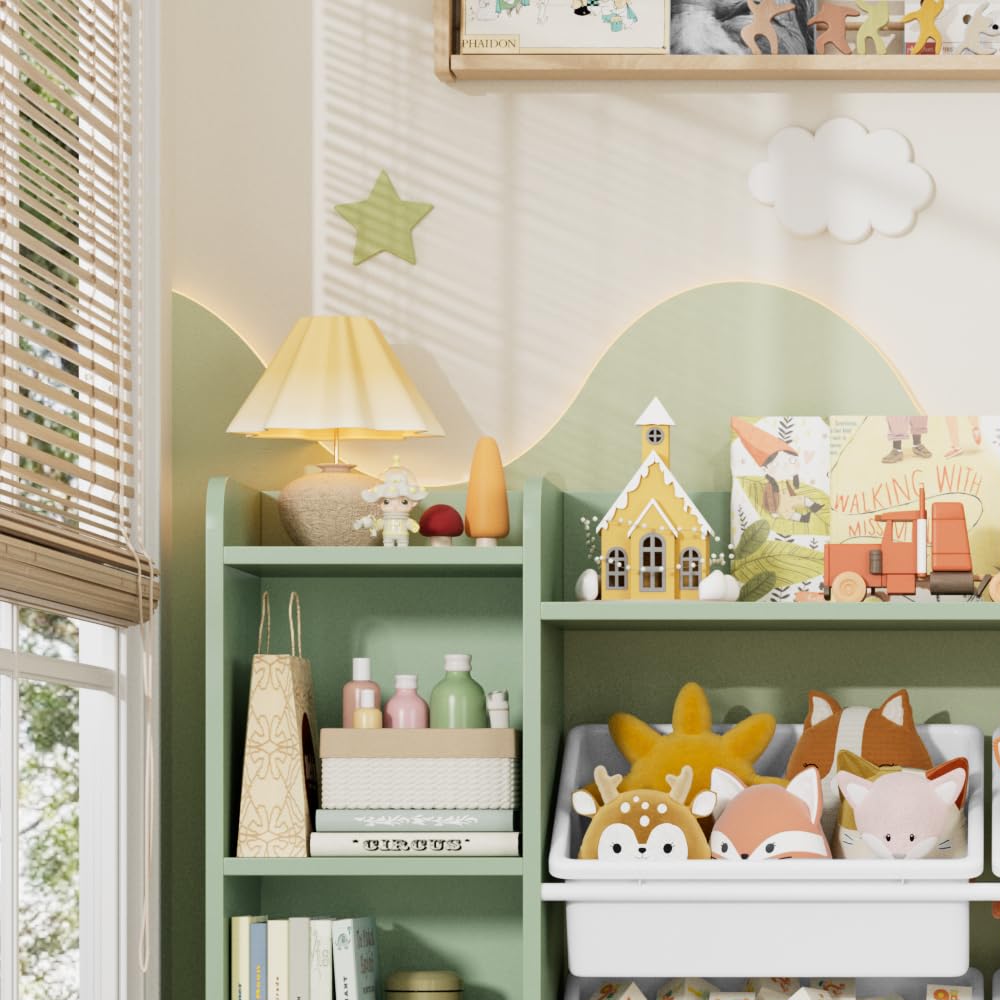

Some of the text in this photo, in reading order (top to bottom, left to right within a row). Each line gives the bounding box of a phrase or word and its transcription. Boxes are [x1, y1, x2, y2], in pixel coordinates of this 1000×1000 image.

[462, 39, 516, 49] PHAIDON
[833, 463, 983, 513] WALKING WITH
[848, 518, 886, 537] MISS
[362, 838, 464, 852] CIRCUS
